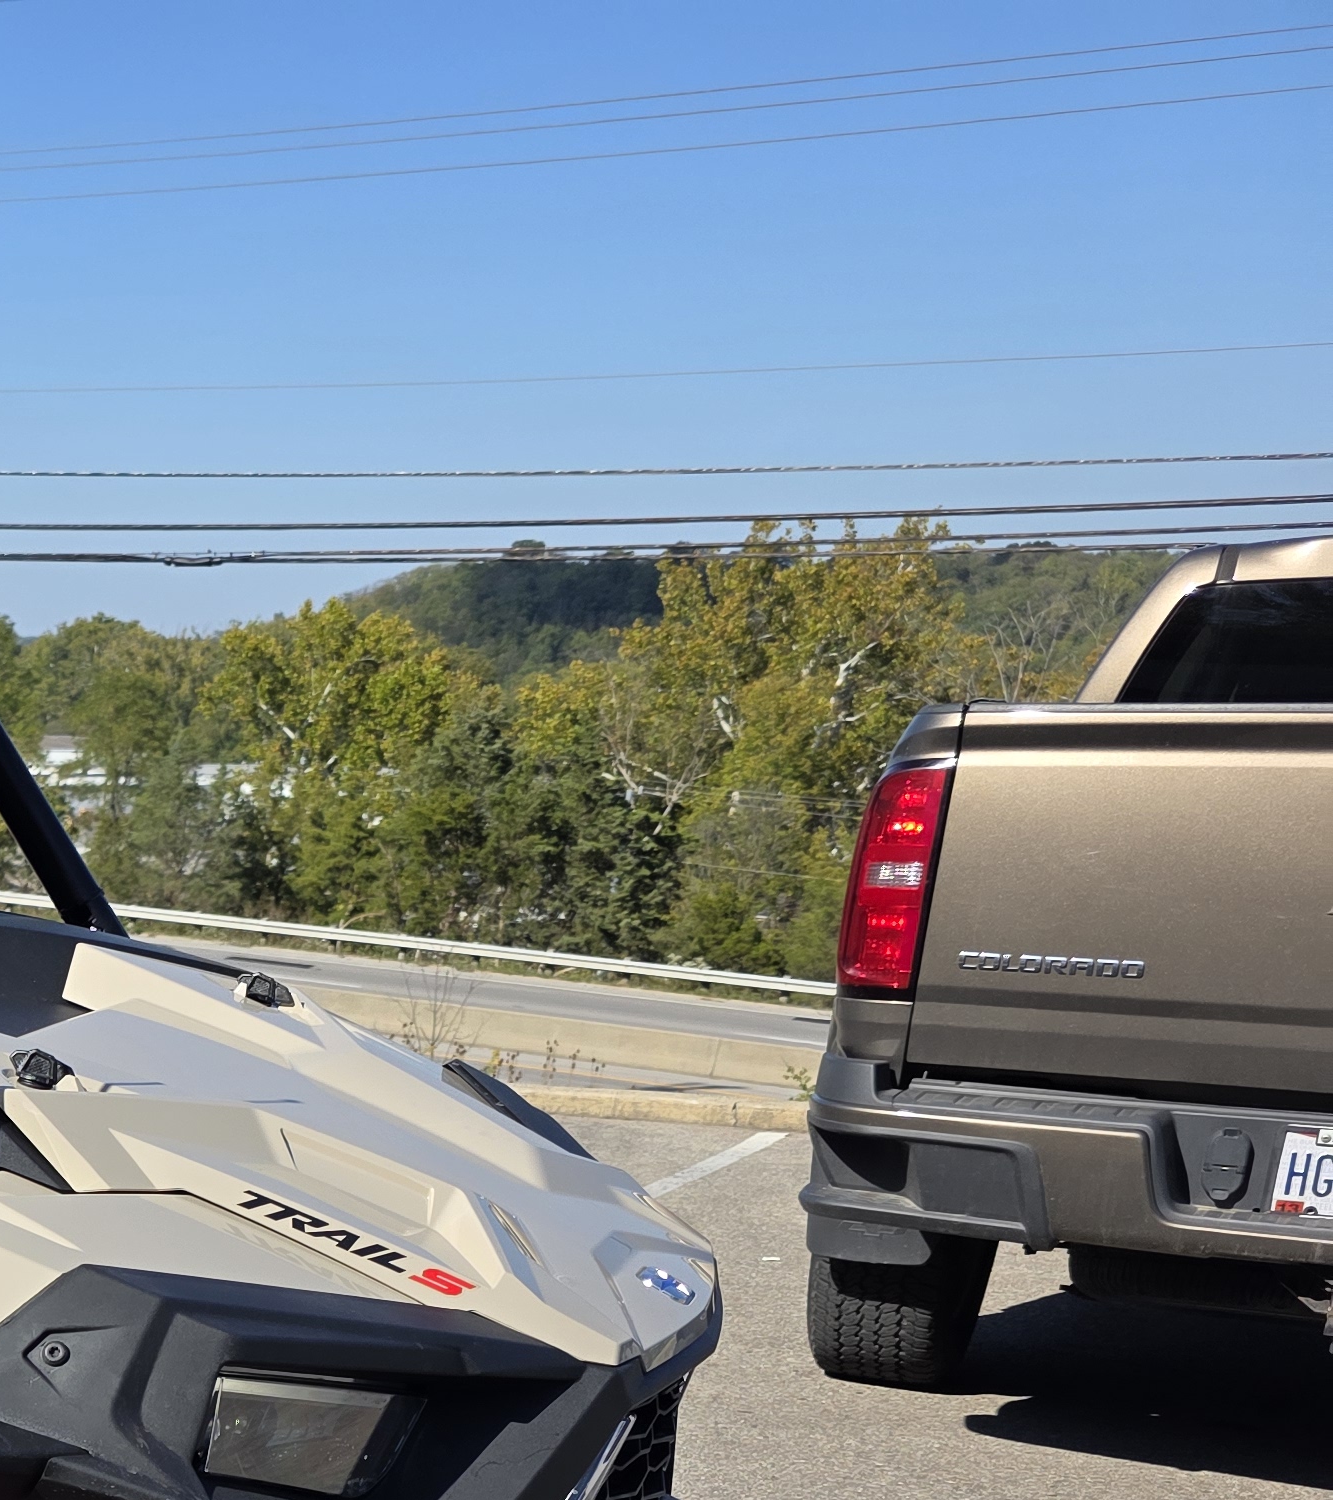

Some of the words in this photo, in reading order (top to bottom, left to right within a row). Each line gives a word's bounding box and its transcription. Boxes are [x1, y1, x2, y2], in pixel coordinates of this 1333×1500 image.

[958, 950, 1146, 979] COLORADO
[1284, 1151, 1333, 1198] HG
[236, 1190, 408, 1273] TRAIL
[408, 1267, 476, 1296] S
